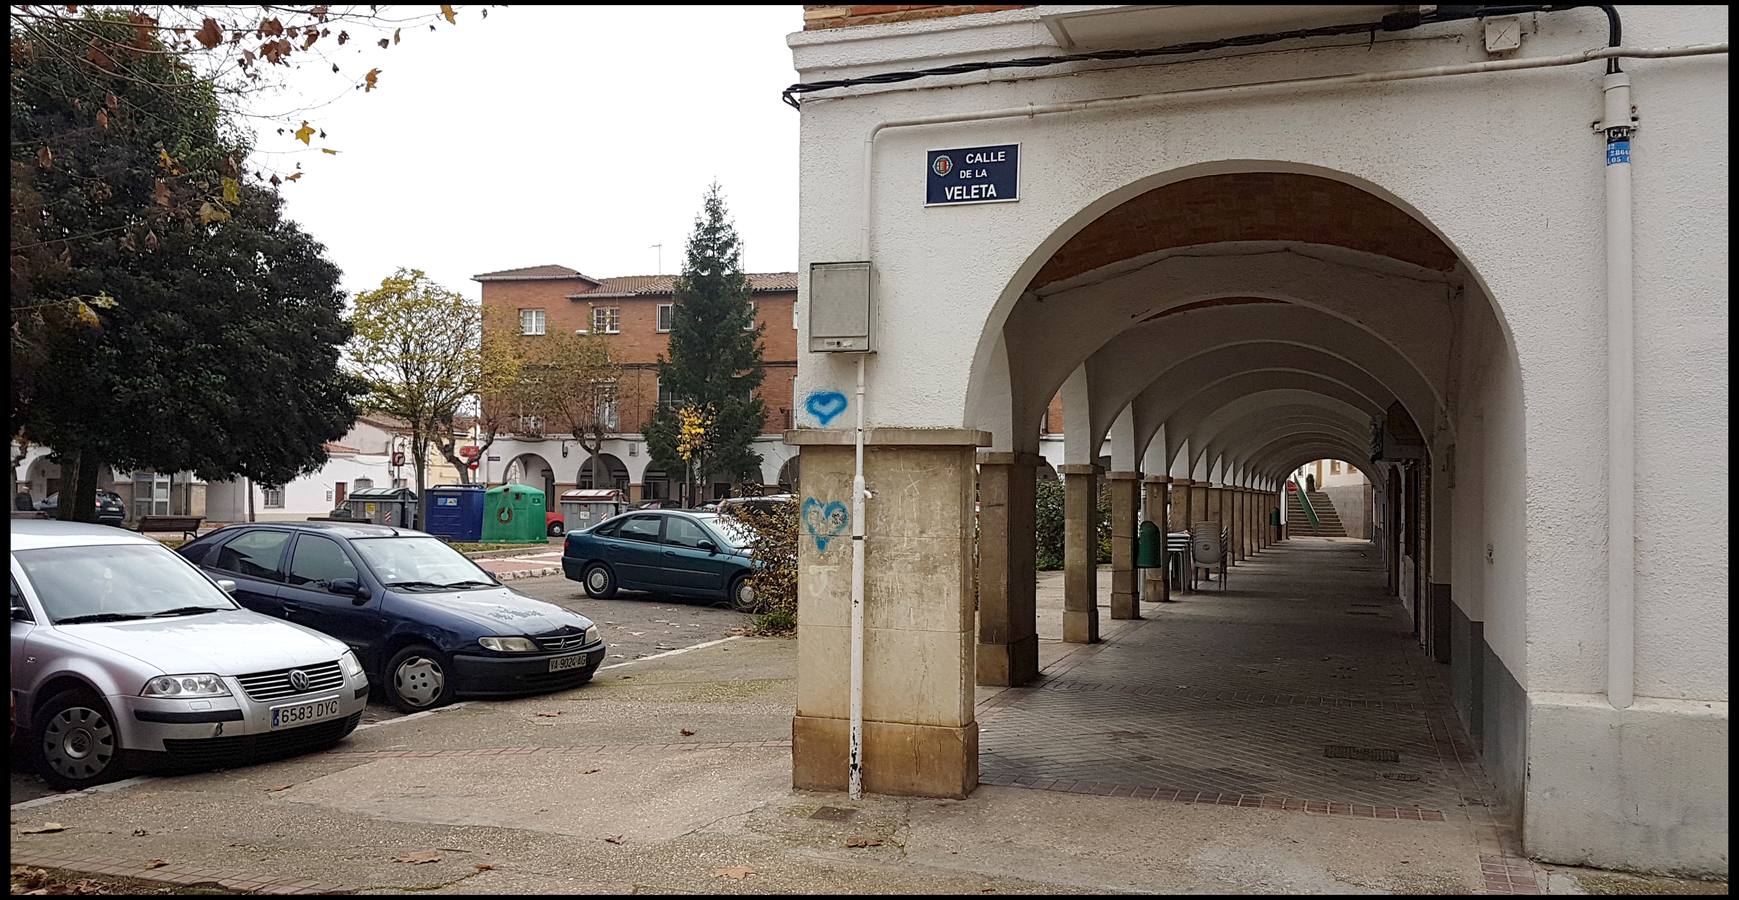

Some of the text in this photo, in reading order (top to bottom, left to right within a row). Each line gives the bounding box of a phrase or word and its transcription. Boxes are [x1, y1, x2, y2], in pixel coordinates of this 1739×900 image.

[965, 151, 1006, 164] CALLE
[959, 169, 988, 179] DE LA
[945, 184, 997, 200] VELETA
[281, 706, 313, 723] 6583
[317, 700, 338, 717] DYC
